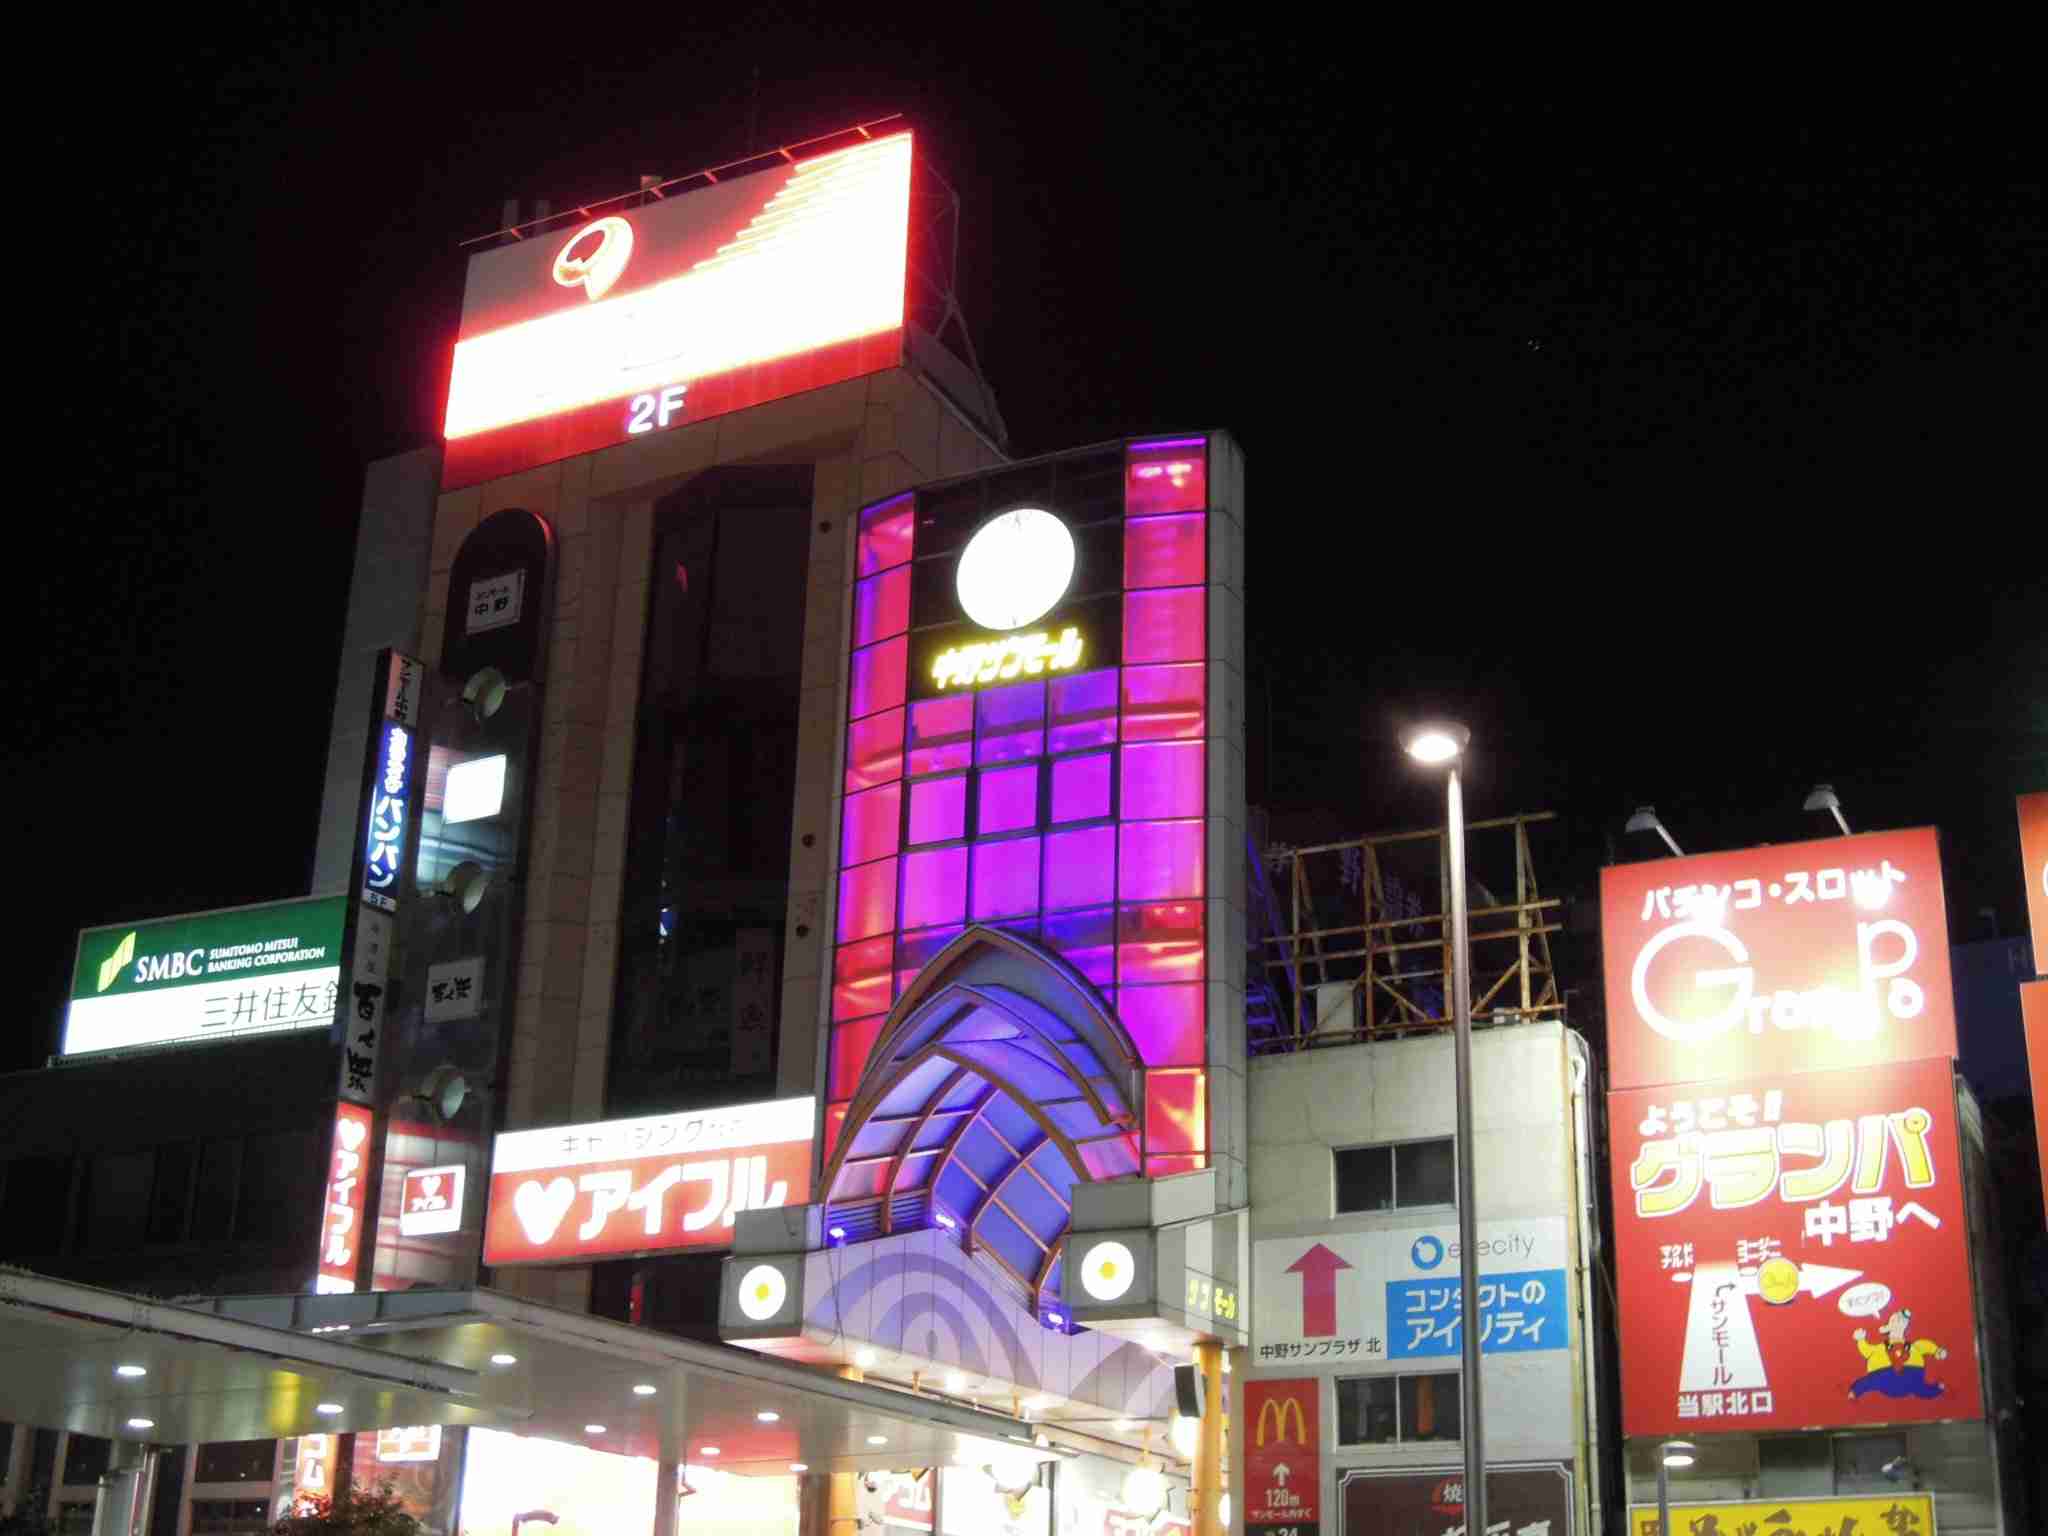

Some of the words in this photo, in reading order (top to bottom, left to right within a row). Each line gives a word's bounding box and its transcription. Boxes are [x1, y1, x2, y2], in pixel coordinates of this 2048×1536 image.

[628, 385, 687, 434] 2F
[134, 948, 205, 984] SMBC
[206, 956, 252, 974] BANKING
[253, 946, 326, 967] CORPORATION
[209, 941, 264, 960] SUMITOMO
[264, 937, 299, 951] MITSUI
[1630, 1107, 1935, 1218] グランパ
[324, 1151, 360, 1267] アイフル
[579, 1156, 788, 1241] アイフル
[1803, 1196, 1942, 1247] 中野へ
[1447, 1233, 1536, 1259] eecity
[1260, 1339, 1361, 1360] 中野サンプラザ
[1366, 1337, 1382, 1354] 北
[1710, 1300, 1733, 1386] サンモール
[1677, 1391, 1774, 1419] 当駅北口
[1265, 1488, 1300, 1507] 120m
